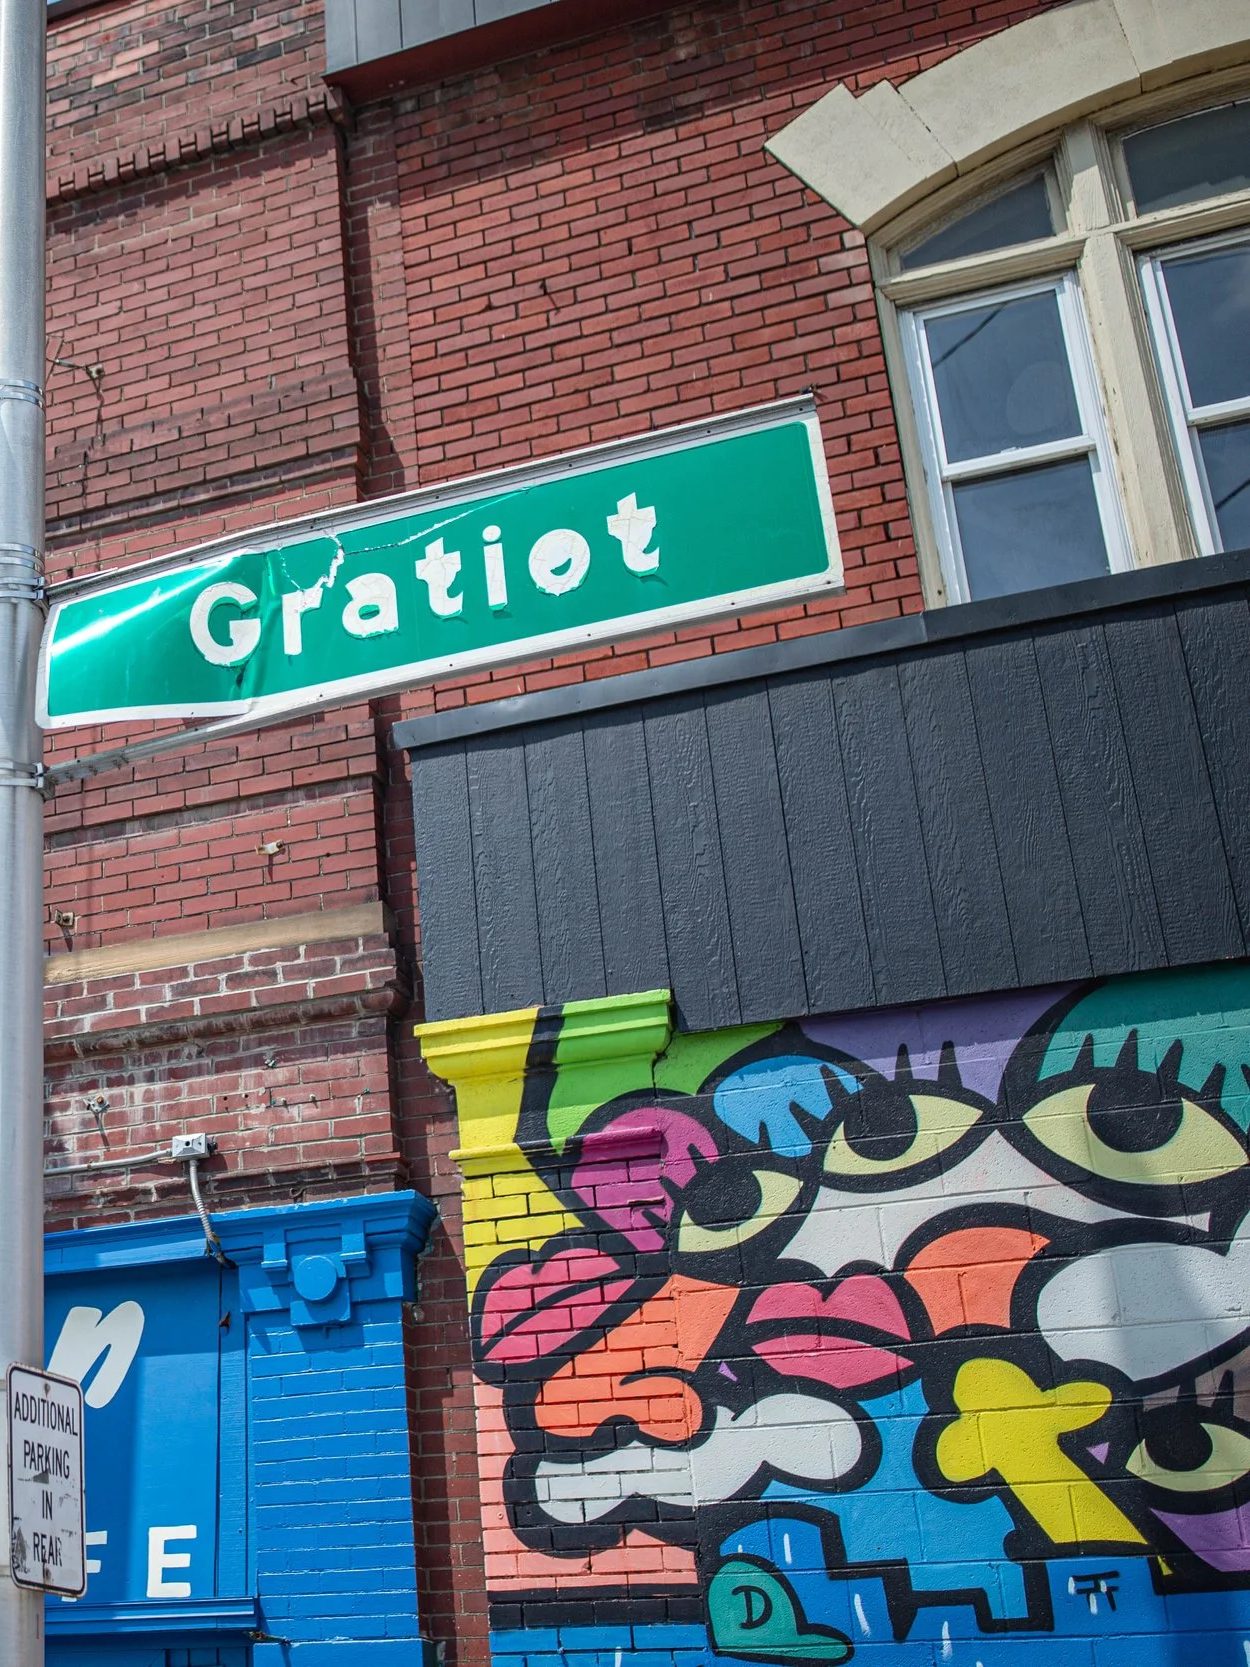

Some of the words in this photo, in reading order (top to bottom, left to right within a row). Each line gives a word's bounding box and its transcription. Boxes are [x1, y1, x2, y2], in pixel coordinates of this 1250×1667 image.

[188, 491, 660, 667] Gratiot
[13, 1391, 78, 1436] ADDITIONAL
[23, 1439, 70, 1480] PARKING
[41, 1489, 53, 1521] IN
[33, 1531, 62, 1567] REAR
